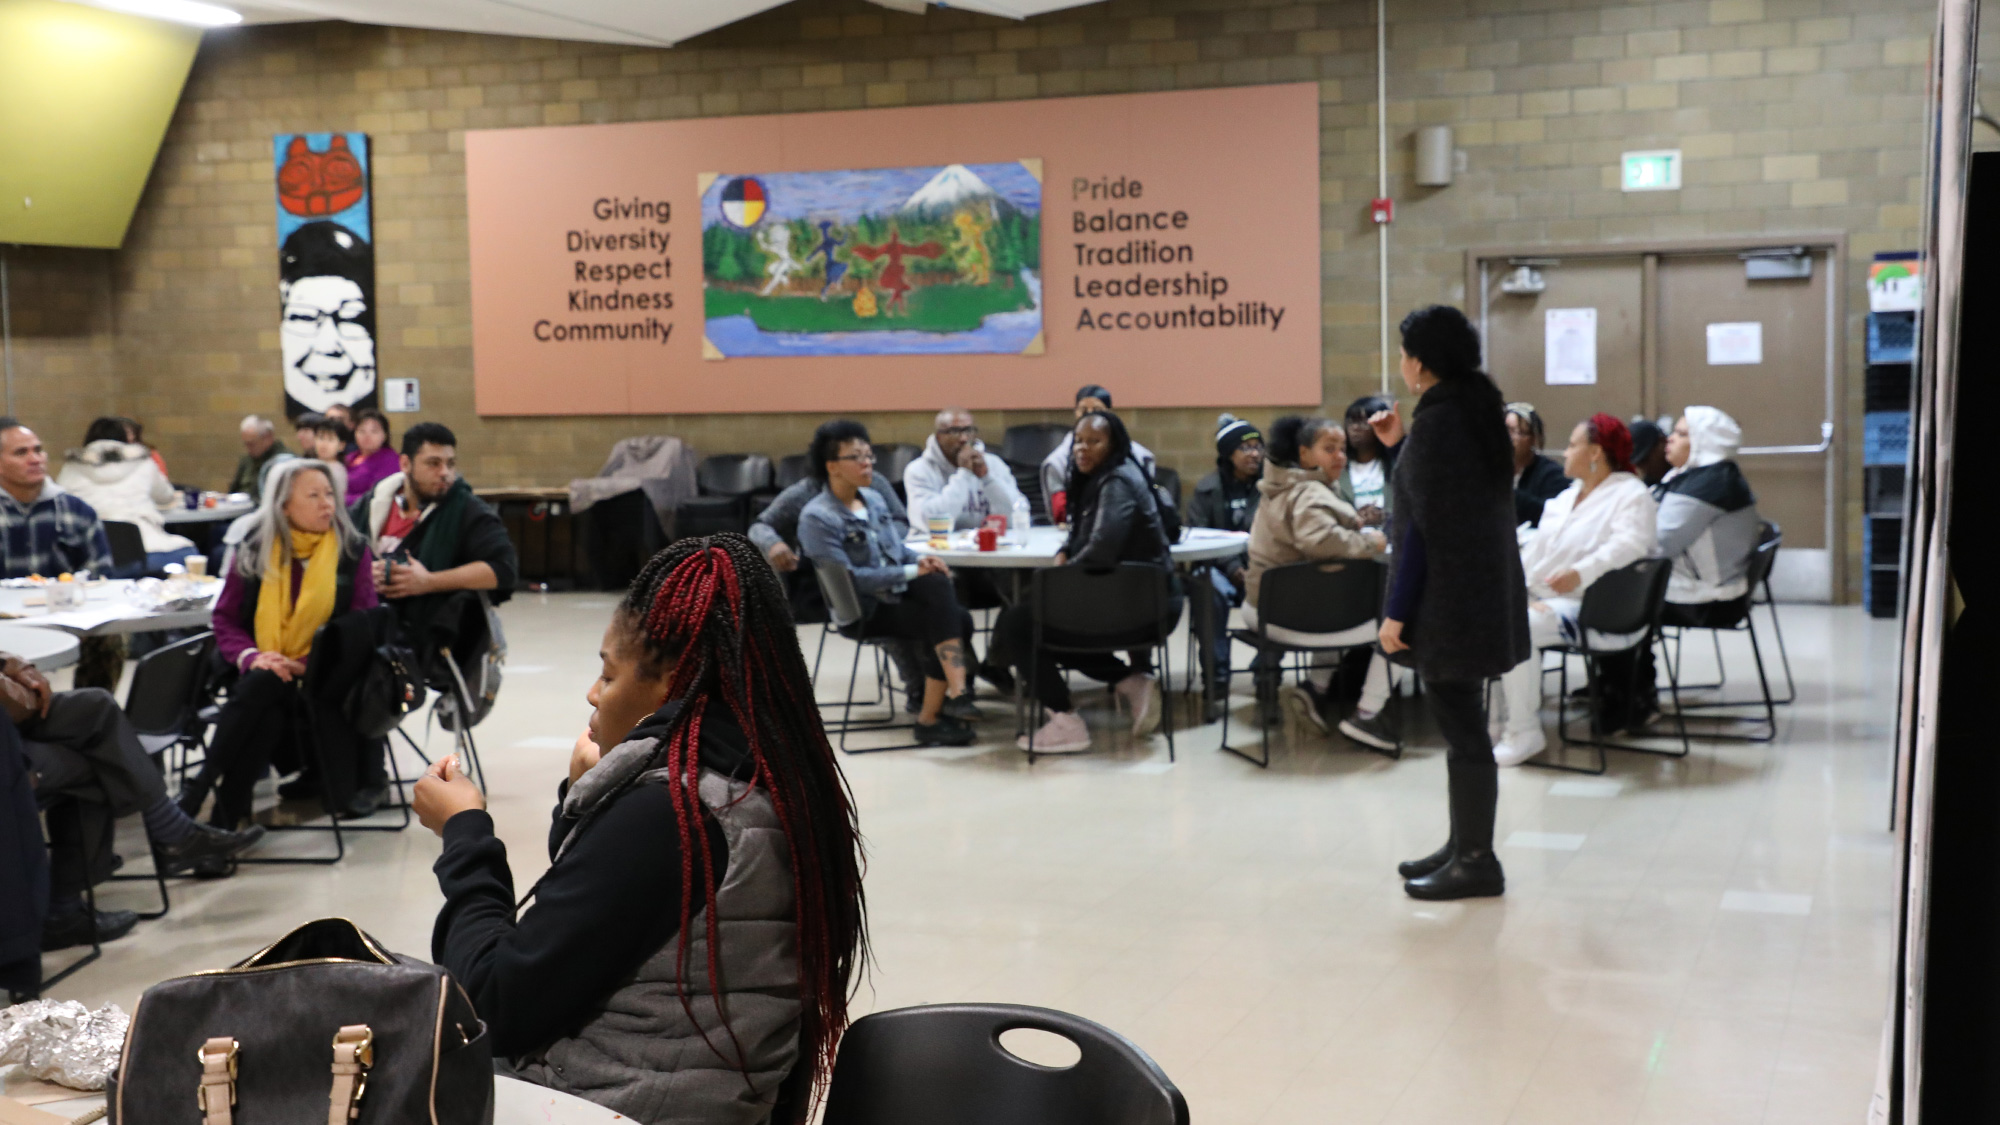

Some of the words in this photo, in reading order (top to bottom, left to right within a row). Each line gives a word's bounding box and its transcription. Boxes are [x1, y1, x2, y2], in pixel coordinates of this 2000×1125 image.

[1626, 156, 1674, 187] EIT
[1072, 175, 1143, 201] Pride
[593, 197, 672, 225] Giving
[1073, 209, 1190, 234] Balance
[567, 228, 671, 255] Diversity
[1074, 240, 1193, 266] Tradition
[575, 259, 672, 286] Respect
[1074, 272, 1229, 301] Leadership
[568, 289, 674, 312] Kindness
[1076, 302, 1286, 332] Accountability
[533, 317, 674, 345] Community
